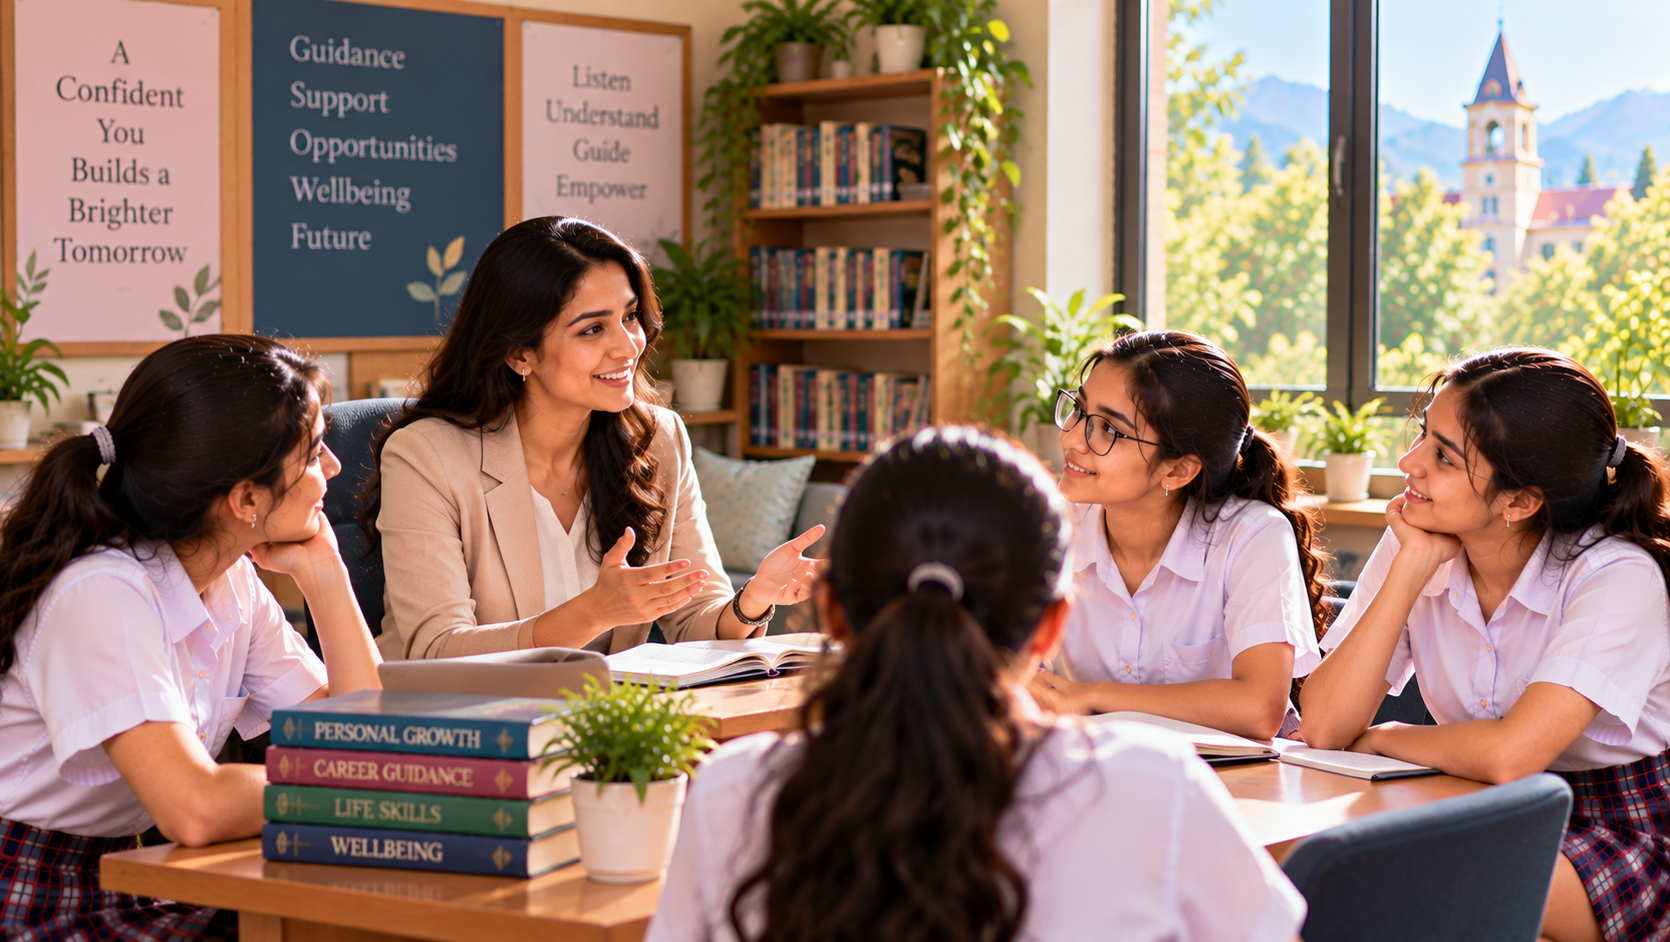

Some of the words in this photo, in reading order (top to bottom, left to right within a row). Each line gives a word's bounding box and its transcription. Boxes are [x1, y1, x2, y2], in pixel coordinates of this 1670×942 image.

[111, 40, 130, 64] A
[290, 34, 405, 70] Guidance
[56, 75, 184, 108] Confident
[572, 65, 631, 92] Listen
[290, 81, 390, 117] Support
[546, 99, 659, 129] Understand
[97, 118, 145, 145] You
[289, 128, 458, 164] Opportunities
[573, 138, 631, 164] Guide
[71, 157, 149, 185] Builds
[157, 167, 170, 185] a
[290, 176, 411, 213] Wellbeing
[556, 174, 648, 204] Empower
[68, 197, 174, 231] Brighter
[54, 237, 188, 264] Tomorrow
[291, 223, 372, 250] Future
[314, 721, 399, 744] PERSONAL
[403, 725, 481, 749] GROWTH
[314, 759, 379, 781] CAREER
[382, 762, 474, 787] GUIDANCE
[334, 798, 375, 818] LIFE
[379, 802, 442, 824] SKILLS
[330, 836, 443, 862] WELLBEING
